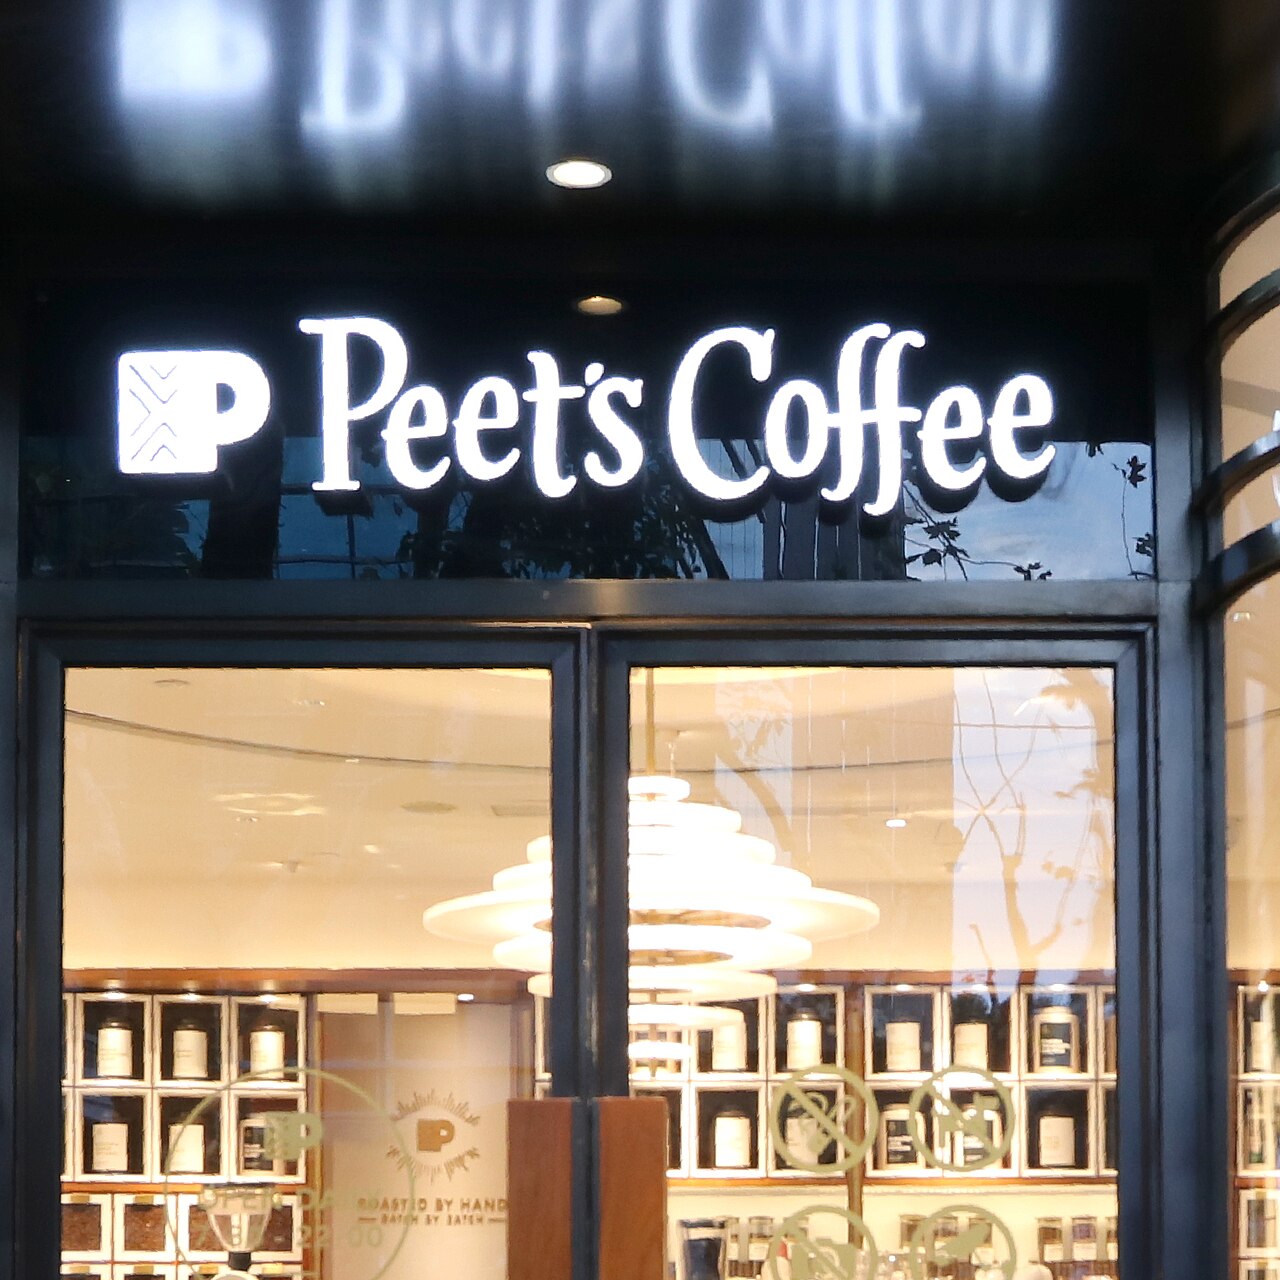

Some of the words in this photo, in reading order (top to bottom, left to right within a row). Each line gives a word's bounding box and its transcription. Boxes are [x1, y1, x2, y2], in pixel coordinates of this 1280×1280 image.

[298, 315, 644, 498] Peet's
[668, 322, 1056, 516] Coffee
[435, 1197, 454, 1212] BY
